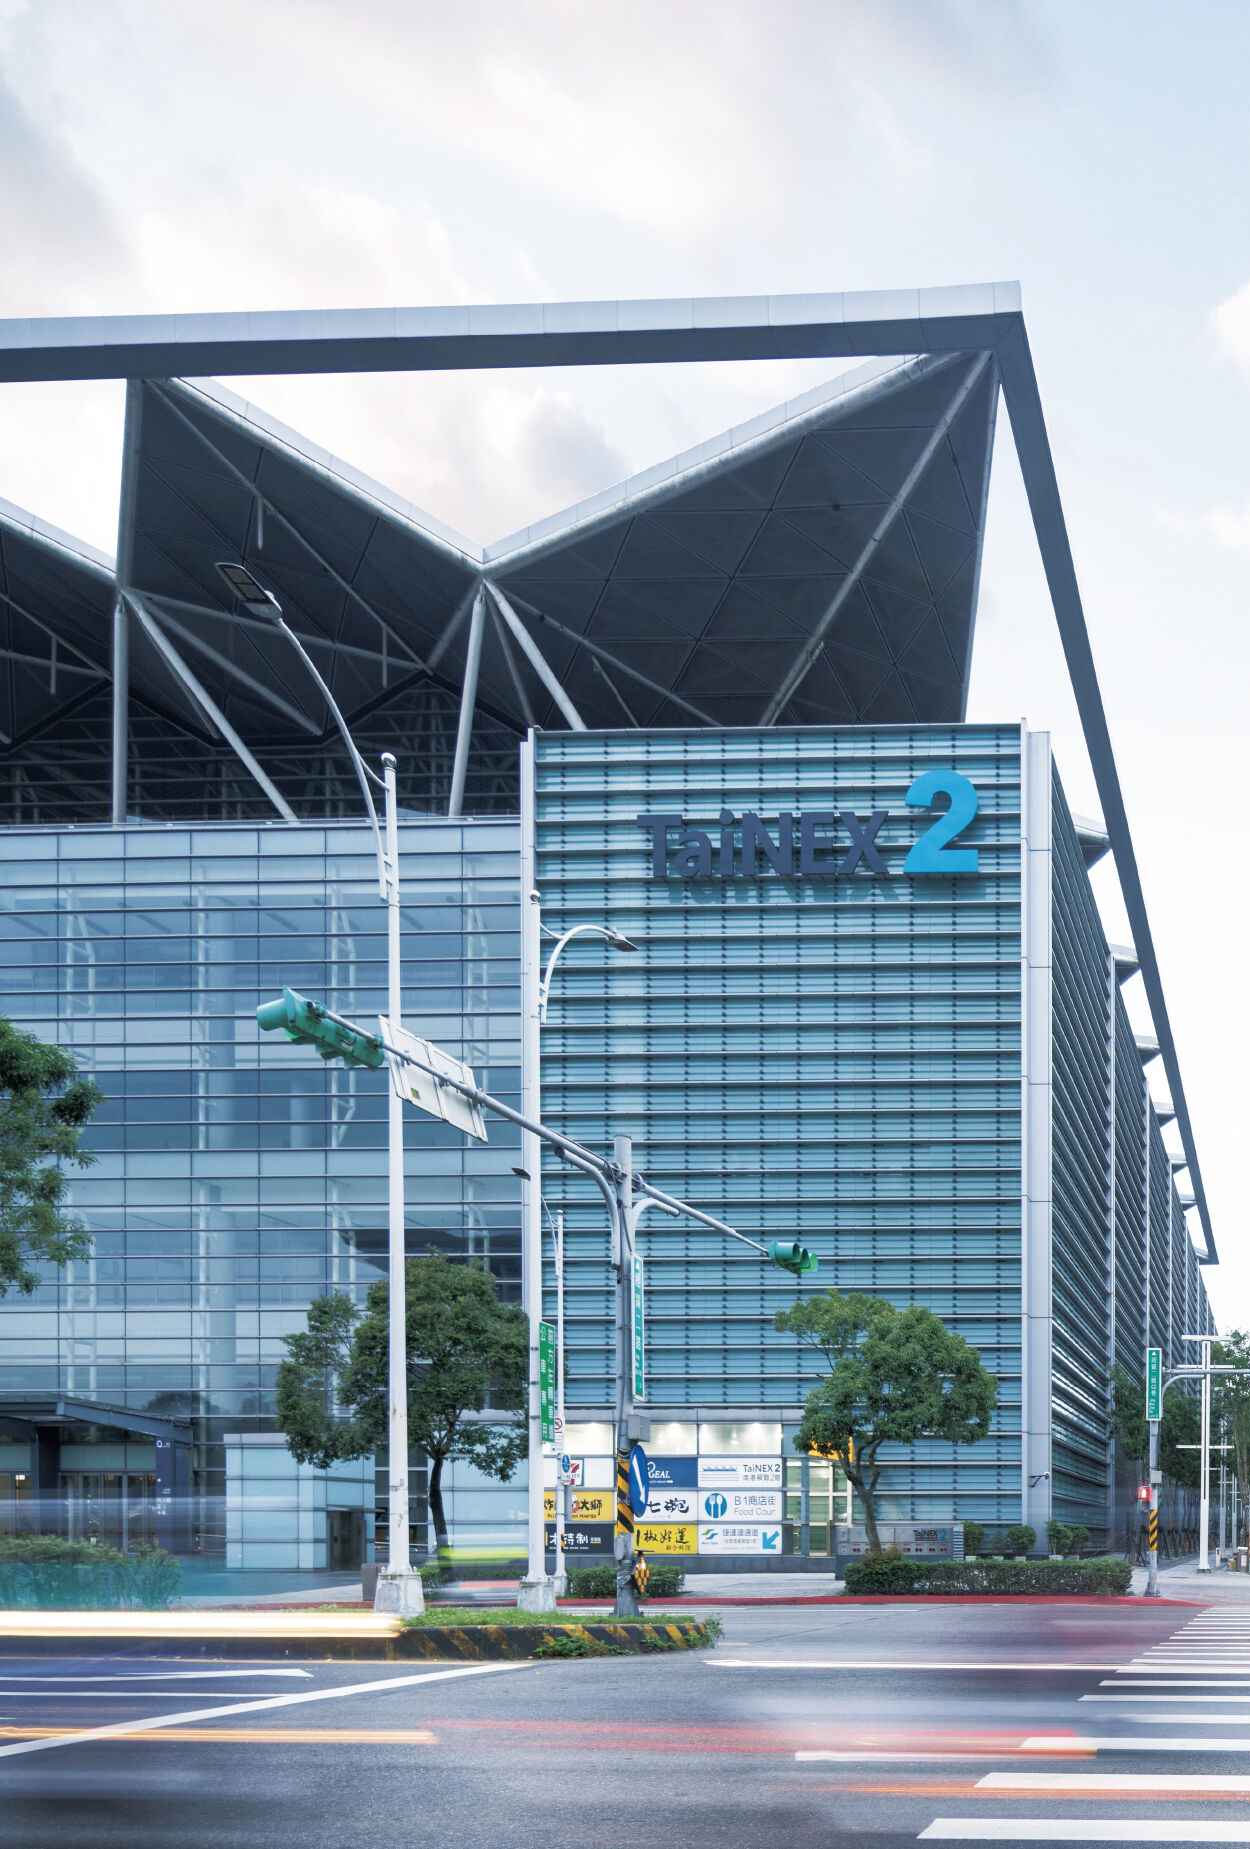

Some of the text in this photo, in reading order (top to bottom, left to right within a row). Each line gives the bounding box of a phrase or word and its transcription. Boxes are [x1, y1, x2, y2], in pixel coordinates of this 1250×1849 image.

[637, 769, 979, 877] TaiNEX 2
[743, 1463, 781, 1473] TaiNEX 2
